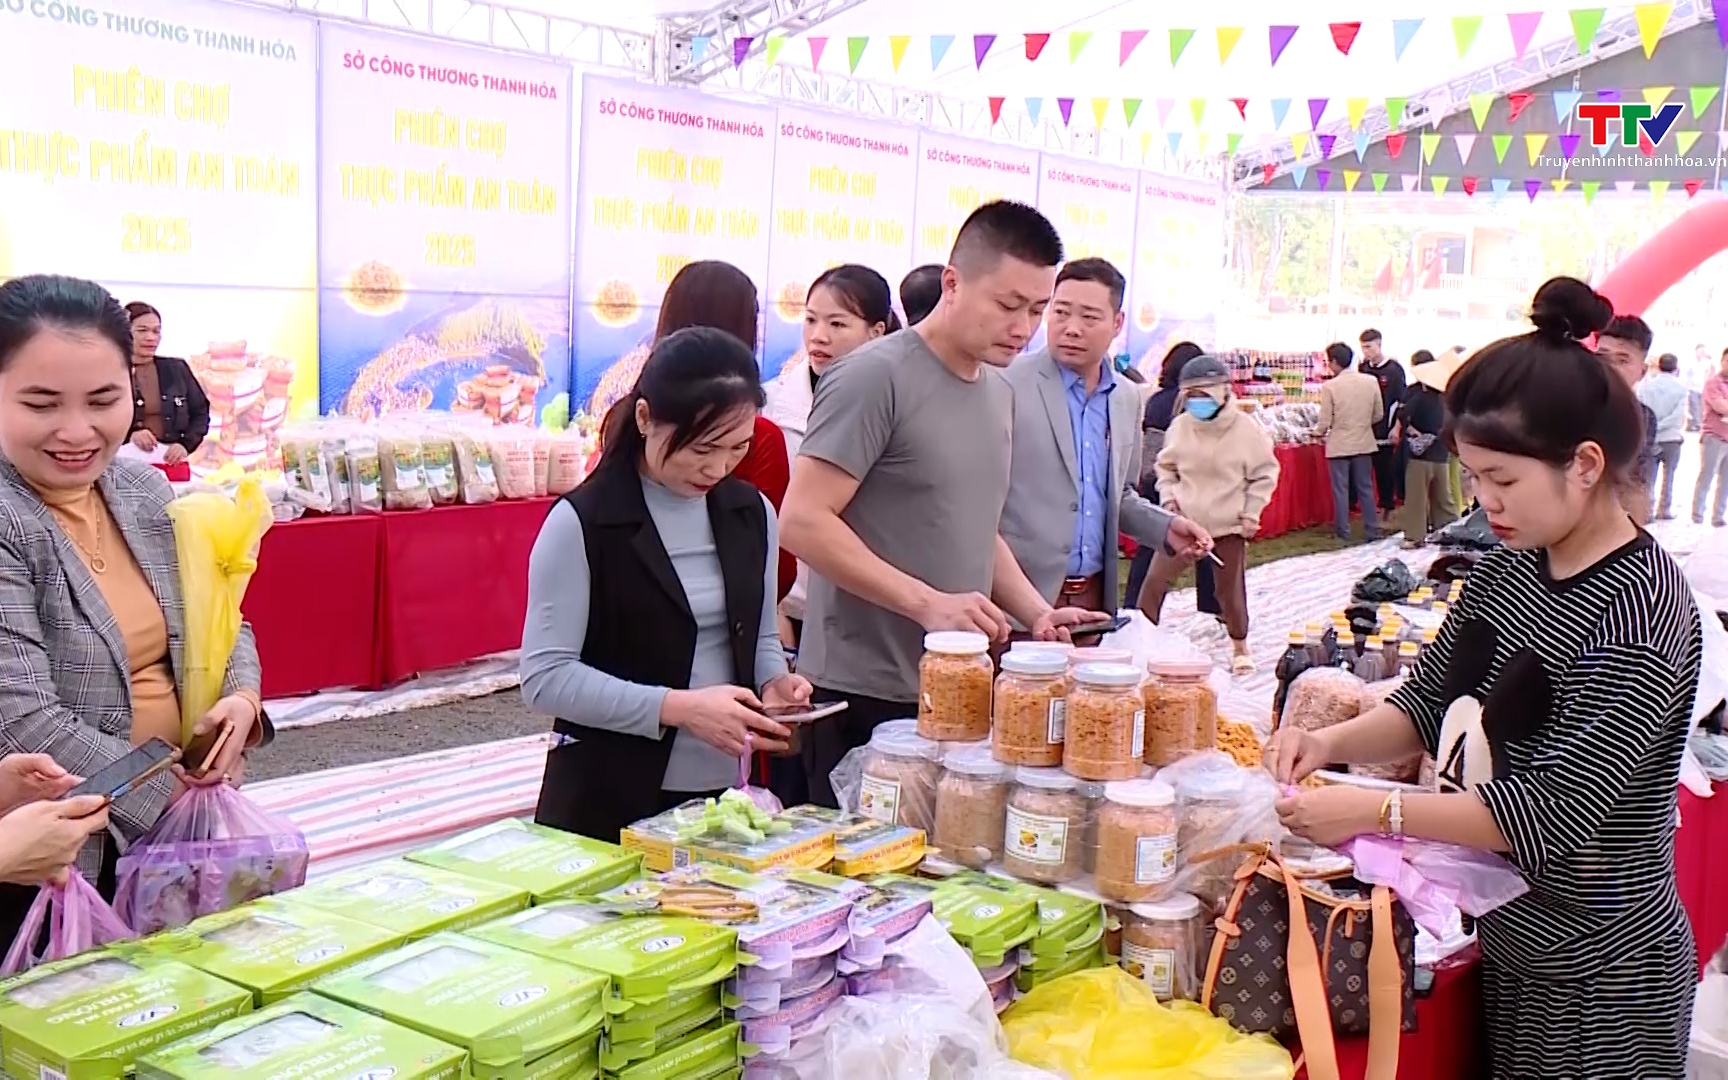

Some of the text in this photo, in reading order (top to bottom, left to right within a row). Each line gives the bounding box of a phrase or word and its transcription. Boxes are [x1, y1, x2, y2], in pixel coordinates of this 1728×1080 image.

[30, 0, 99, 26] CÔNG
[103, 12, 189, 43] THƯƠNG
[193, 28, 254, 54] THANH
[260, 38, 297, 61] HÓA
[73, 63, 230, 133] PHIÊN CHỢ
[343, 50, 557, 100] SỞ CÔNG THƯƠNG THANH HÓA
[395, 105, 507, 161] PHIÊN CHỢ
[599, 98, 764, 138] SỞ CÔNG THƯƠNG THANH HÓA
[781, 122, 909, 157] SỞ CÔNG THƯƠNG THANH HÓA
[0, 128, 299, 197] THỰC PHẨM AN TOÀN
[340, 160, 557, 215] THỰC PHẨM AN TOÀN
[121, 211, 191, 255] 2025
[693, 206, 716, 236] AN
[424, 231, 476, 267] 2025
